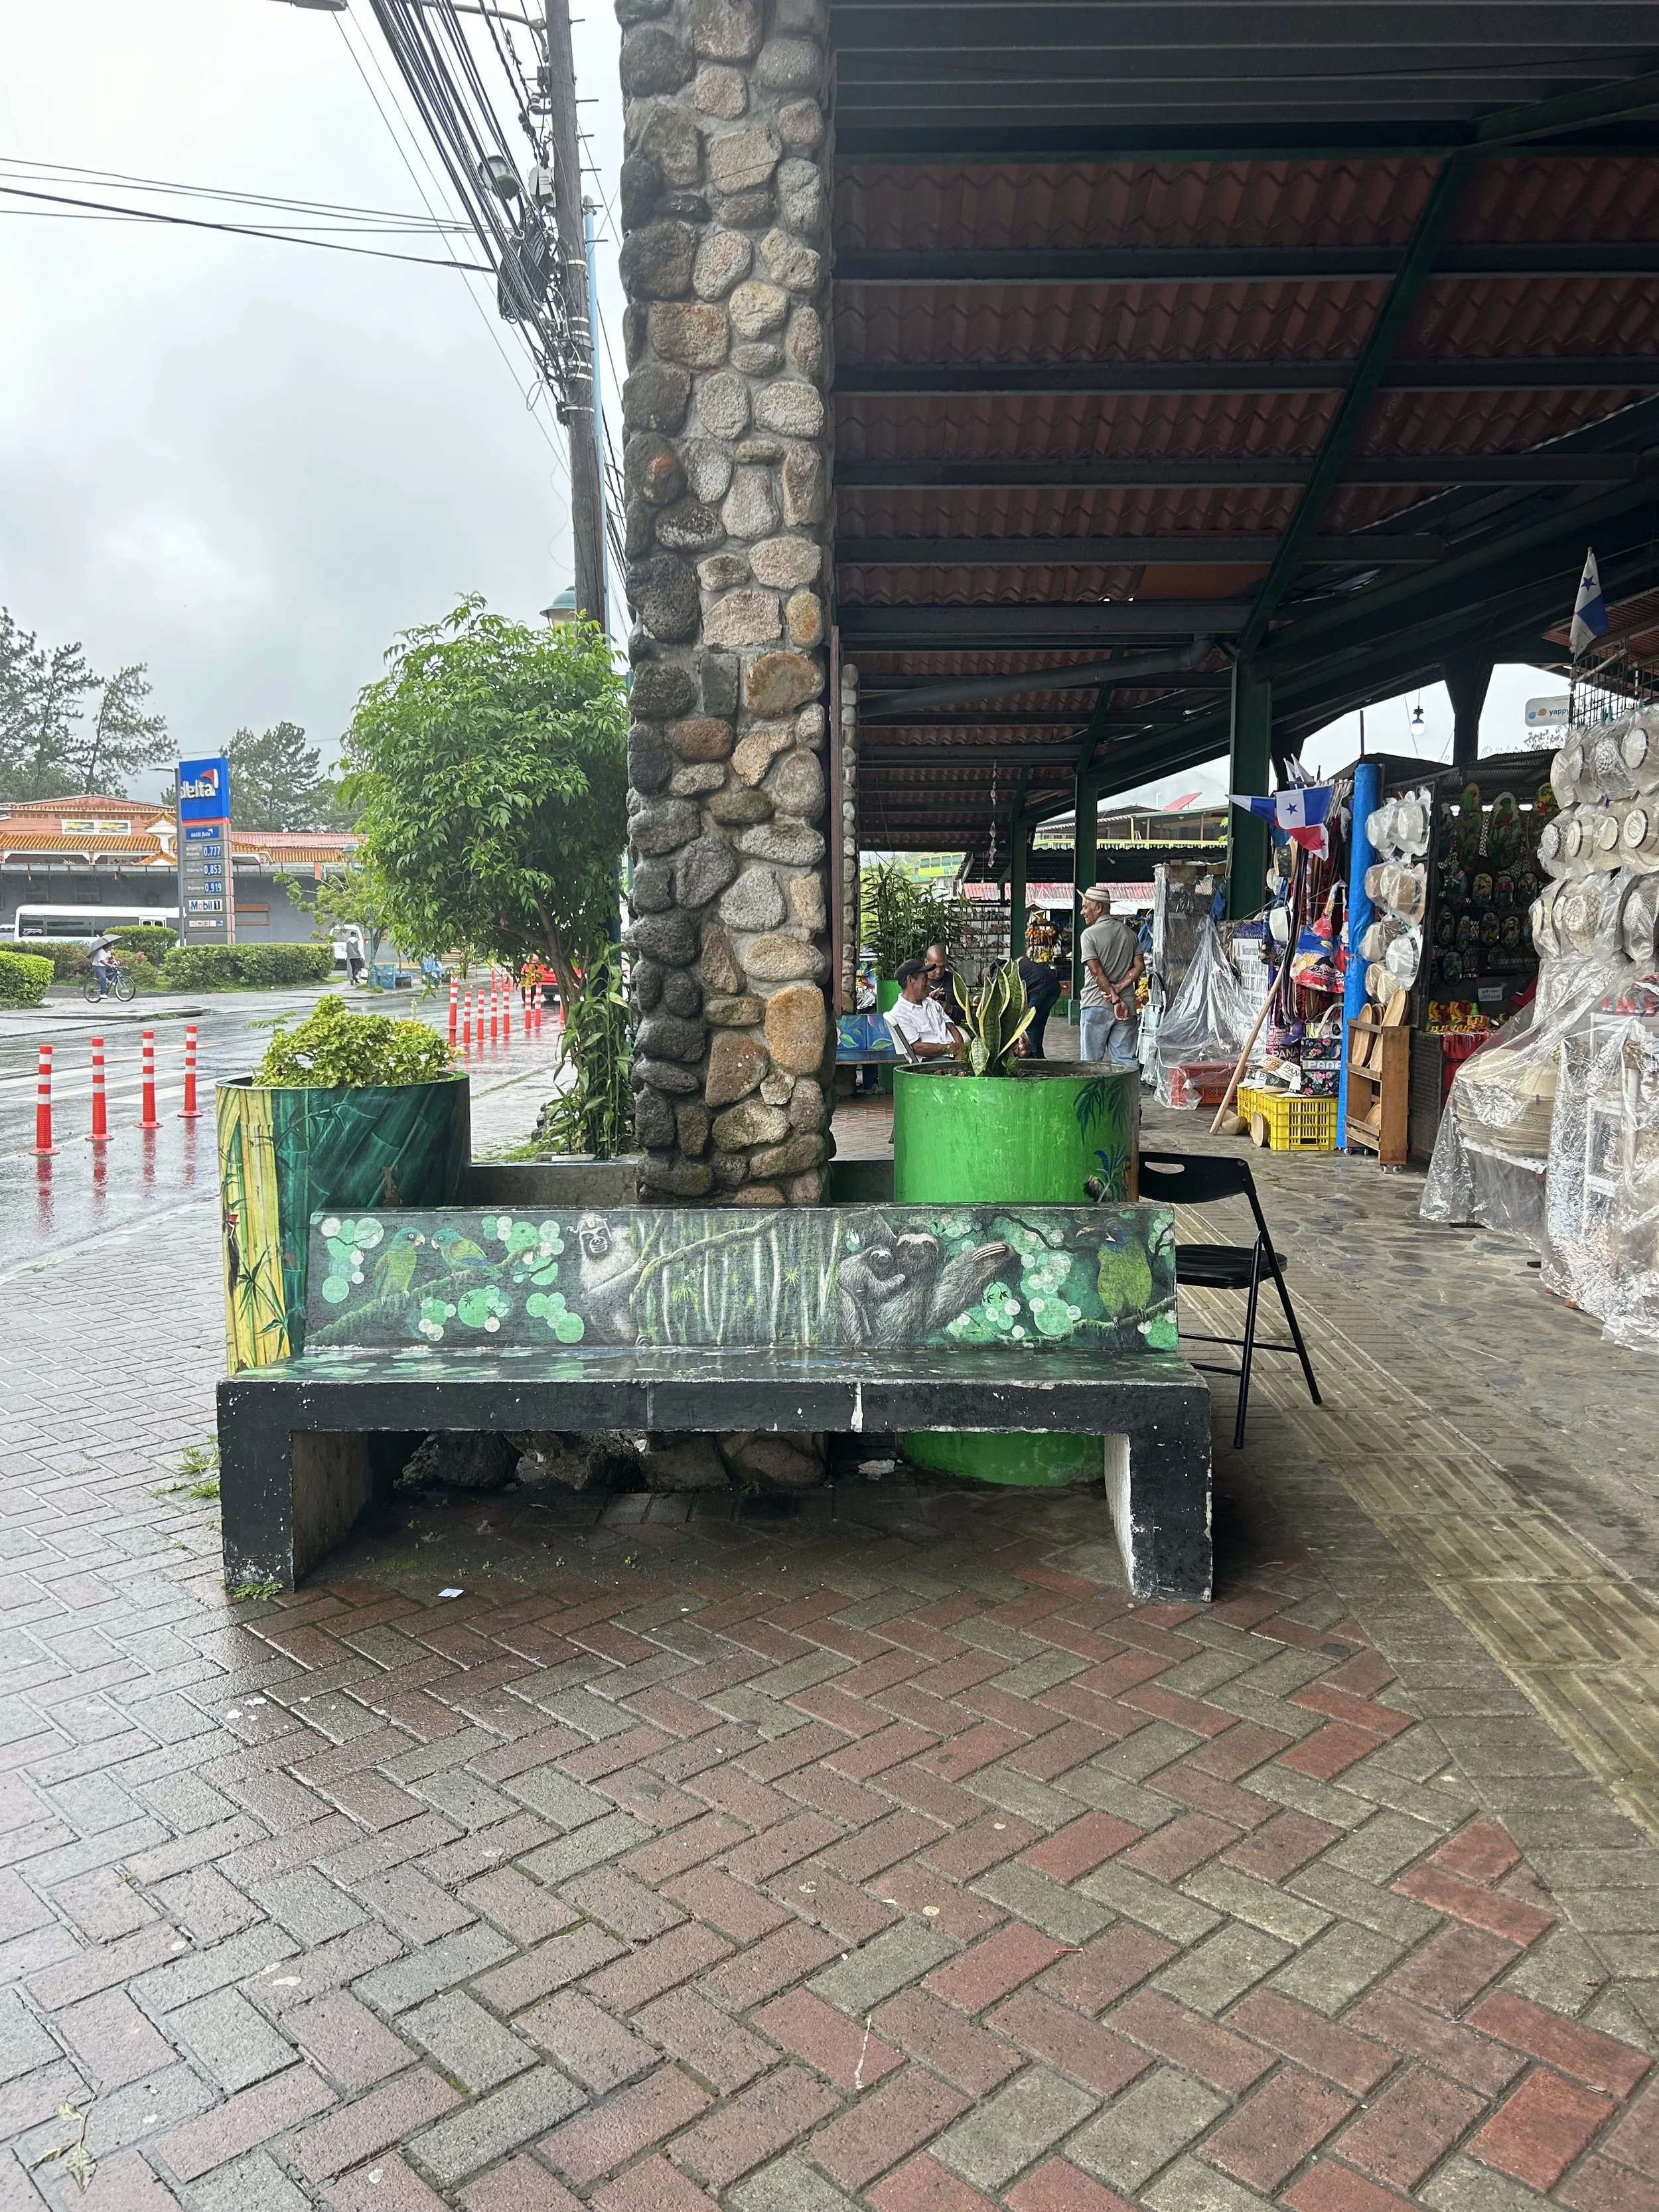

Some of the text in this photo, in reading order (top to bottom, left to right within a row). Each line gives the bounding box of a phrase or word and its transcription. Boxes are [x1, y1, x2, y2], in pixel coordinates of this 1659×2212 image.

[180, 780, 216, 799] delta
[204, 846, 220, 856] 0.777
[204, 864, 222, 875] 0.853
[204, 883, 222, 893] 0.919
[190, 900, 212, 910] Mobil
